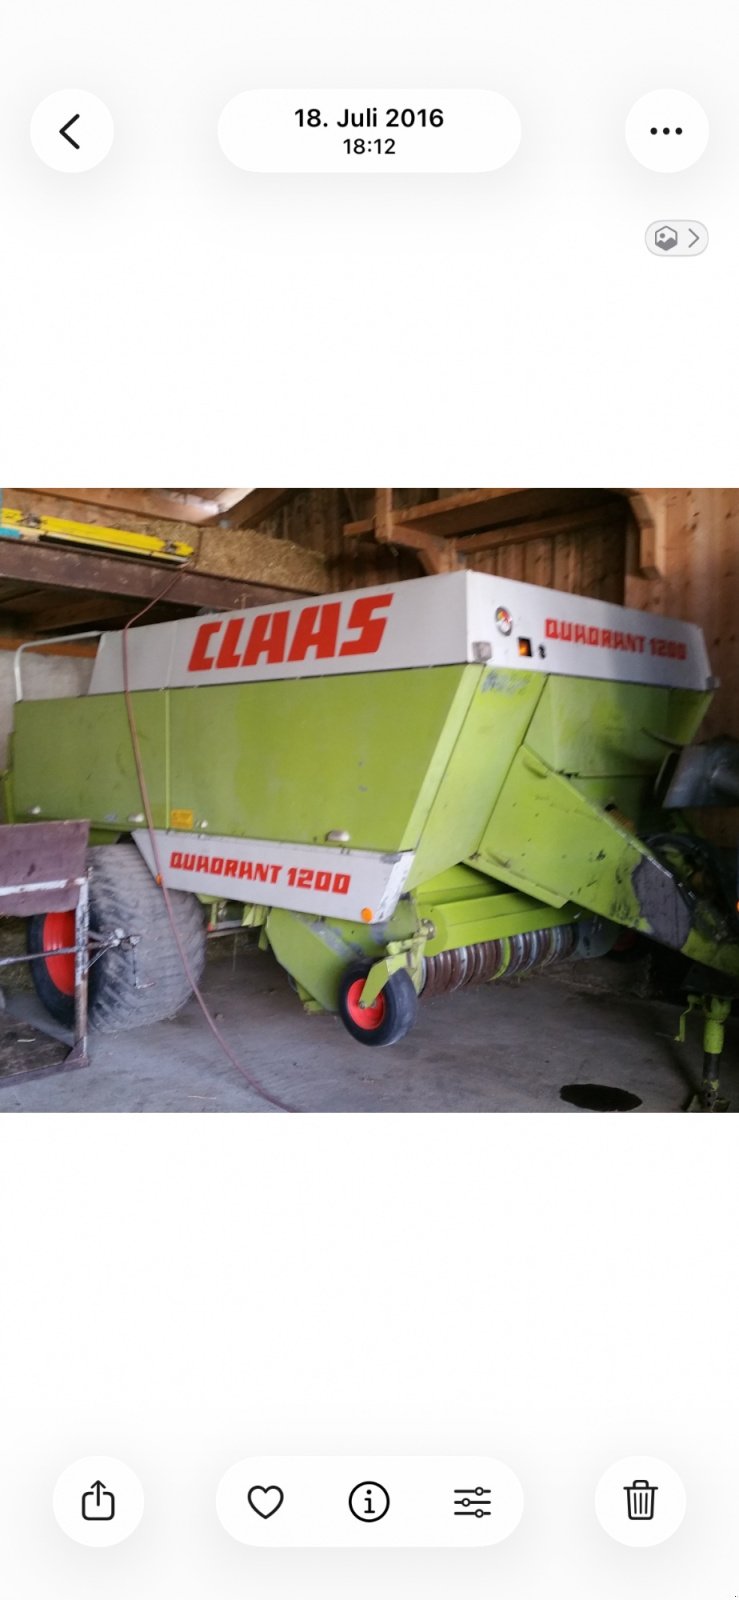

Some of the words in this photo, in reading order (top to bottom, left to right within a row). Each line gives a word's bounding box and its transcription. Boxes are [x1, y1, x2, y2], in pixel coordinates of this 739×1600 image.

[188, 593, 394, 672] CLAAS
[545, 618, 646, 653] QUADRANT
[650, 637, 688, 660] 1200
[170, 852, 283, 884] QUADRANT
[287, 867, 351, 895] 1200
